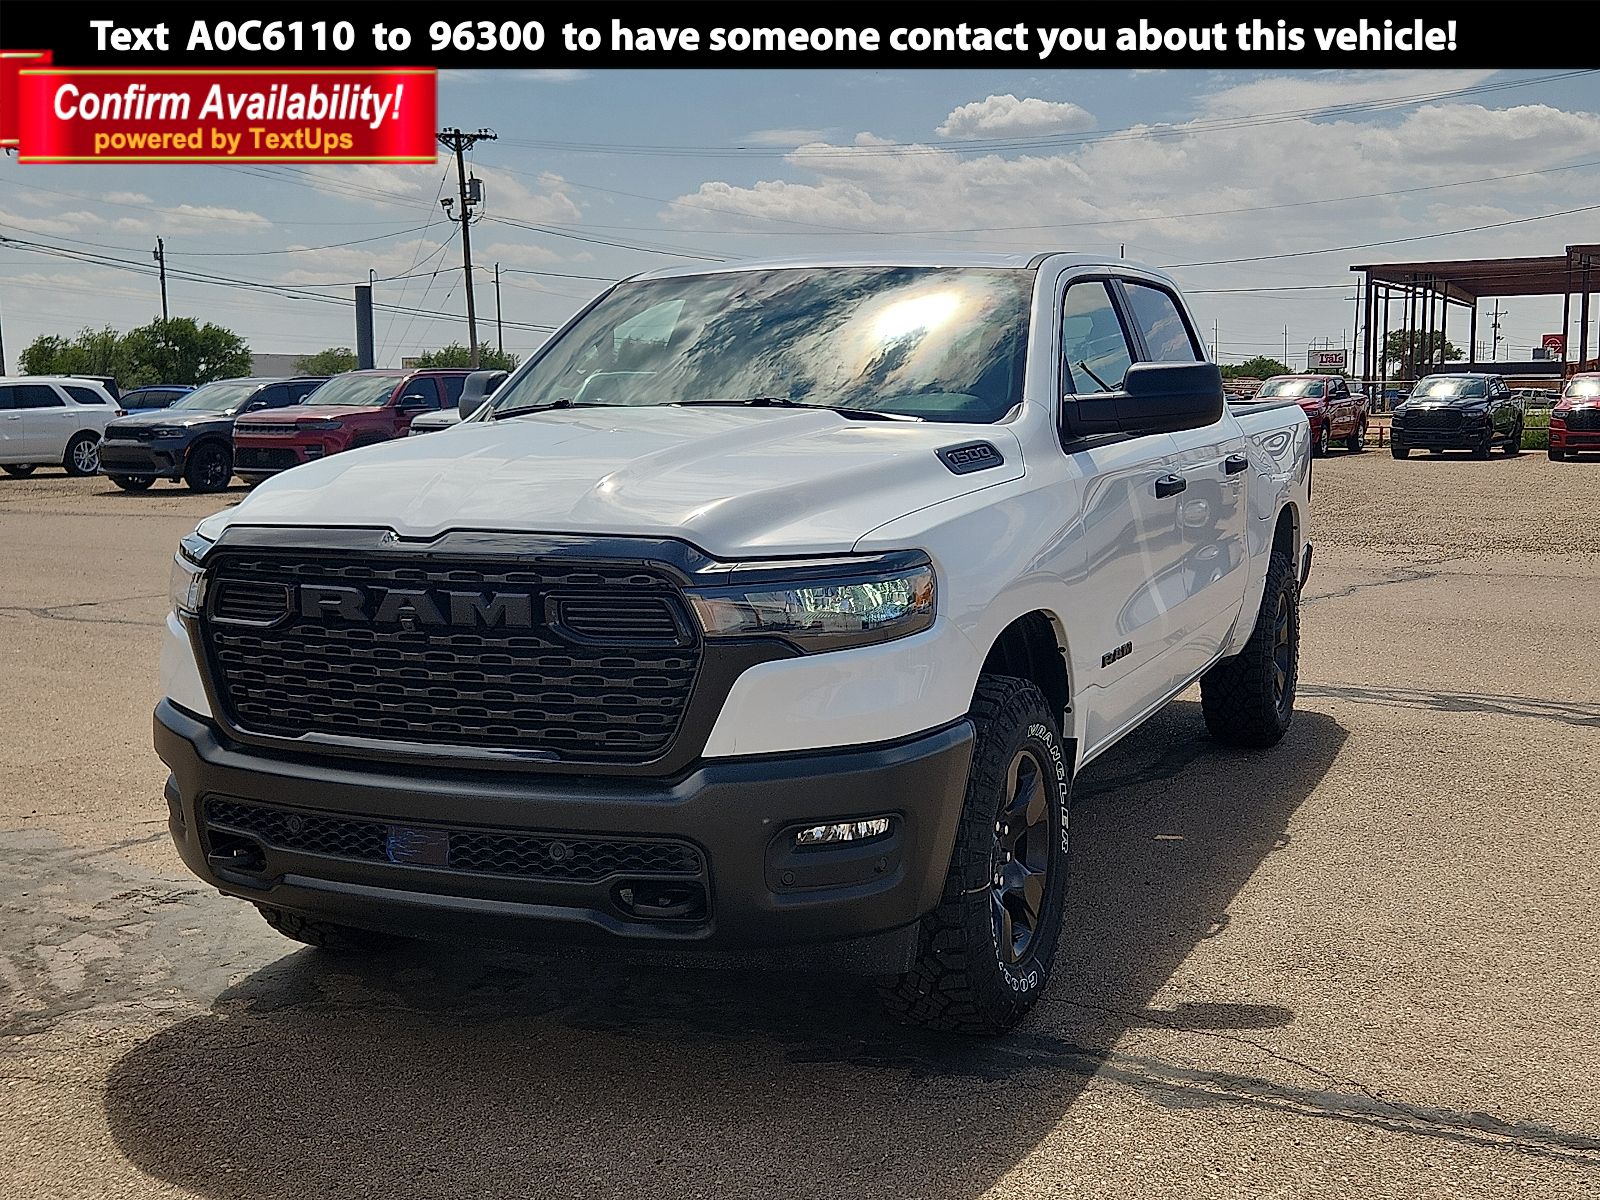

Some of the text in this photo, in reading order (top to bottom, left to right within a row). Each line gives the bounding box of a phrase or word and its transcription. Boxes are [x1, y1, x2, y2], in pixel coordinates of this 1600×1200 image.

[948, 446, 993, 465] 1500
[300, 584, 532, 628] RAM
[1101, 640, 1133, 669] RAM
[1027, 723, 1069, 854] WRANGLER
